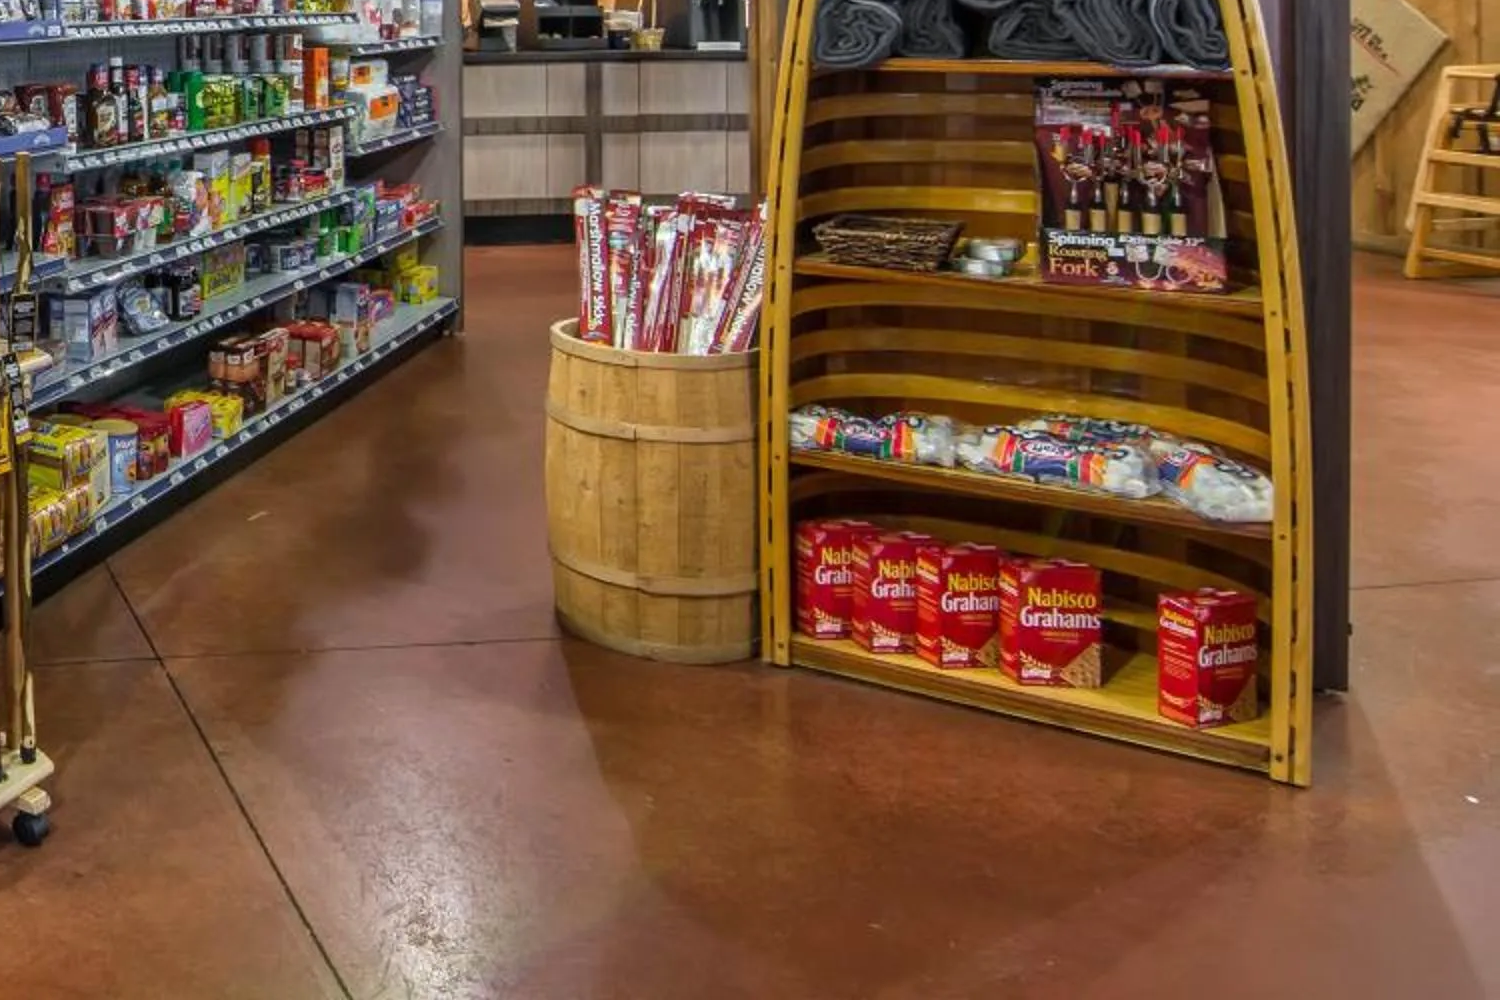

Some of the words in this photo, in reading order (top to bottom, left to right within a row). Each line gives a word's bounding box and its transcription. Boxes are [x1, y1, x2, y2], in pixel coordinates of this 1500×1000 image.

[1048, 231, 1115, 248] Spinning
[1050, 257, 1100, 277] Fork
[815, 564, 852, 585] Grah
[878, 559, 915, 579] Nabi
[871, 577, 916, 599] Grah
[947, 573, 997, 592] Nabisc
[941, 591, 1000, 613] Graham
[1028, 587, 1097, 609] Nabisco
[1020, 605, 1102, 630] Grahams
[1204, 622, 1256, 645] Nabisco
[1198, 641, 1258, 668] Grahams
